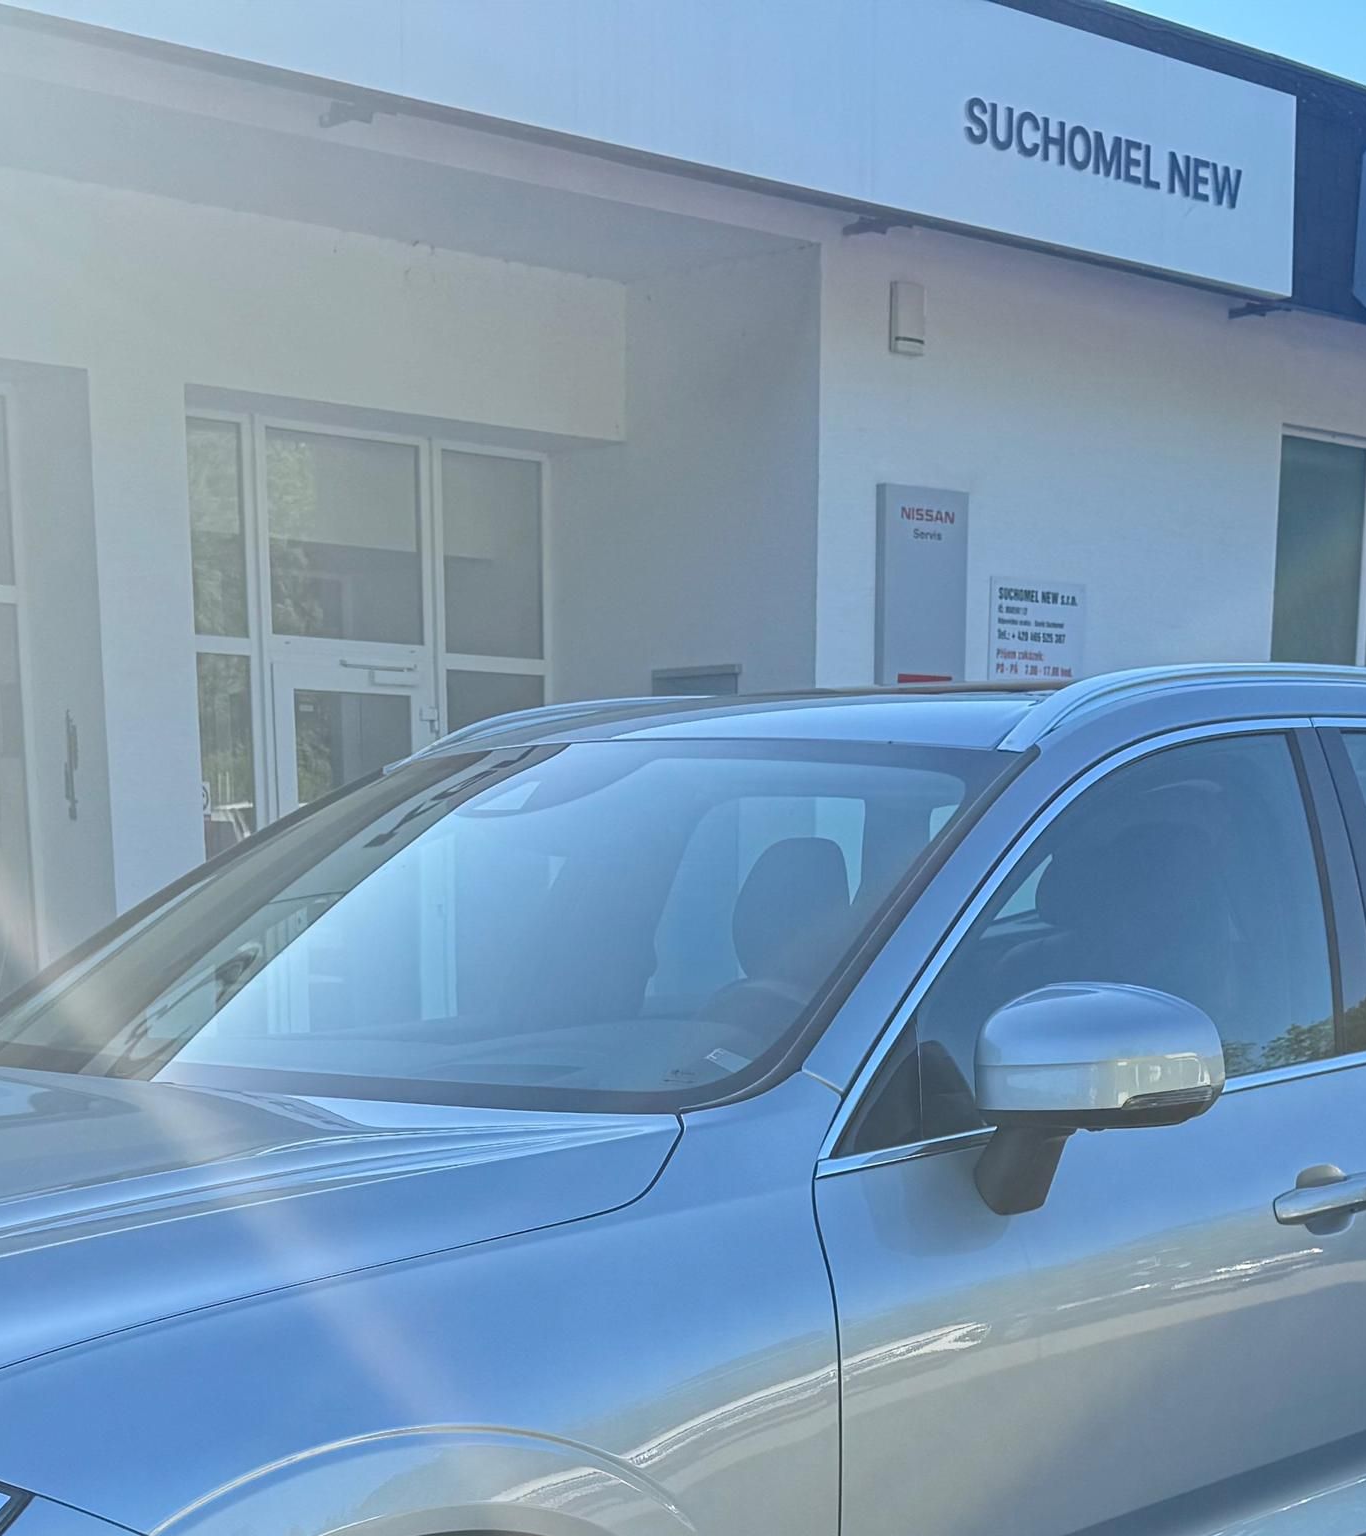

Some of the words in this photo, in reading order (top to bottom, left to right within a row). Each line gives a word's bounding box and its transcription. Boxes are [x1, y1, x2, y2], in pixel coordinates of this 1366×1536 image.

[964, 96, 1160, 191] SUCHOMEL
[1167, 151, 1243, 209] NEW
[900, 506, 955, 525] NISSAN
[913, 528, 942, 541] Servis
[998, 587, 1039, 603] SUCHOMEL
[1041, 591, 1059, 605] NEW
